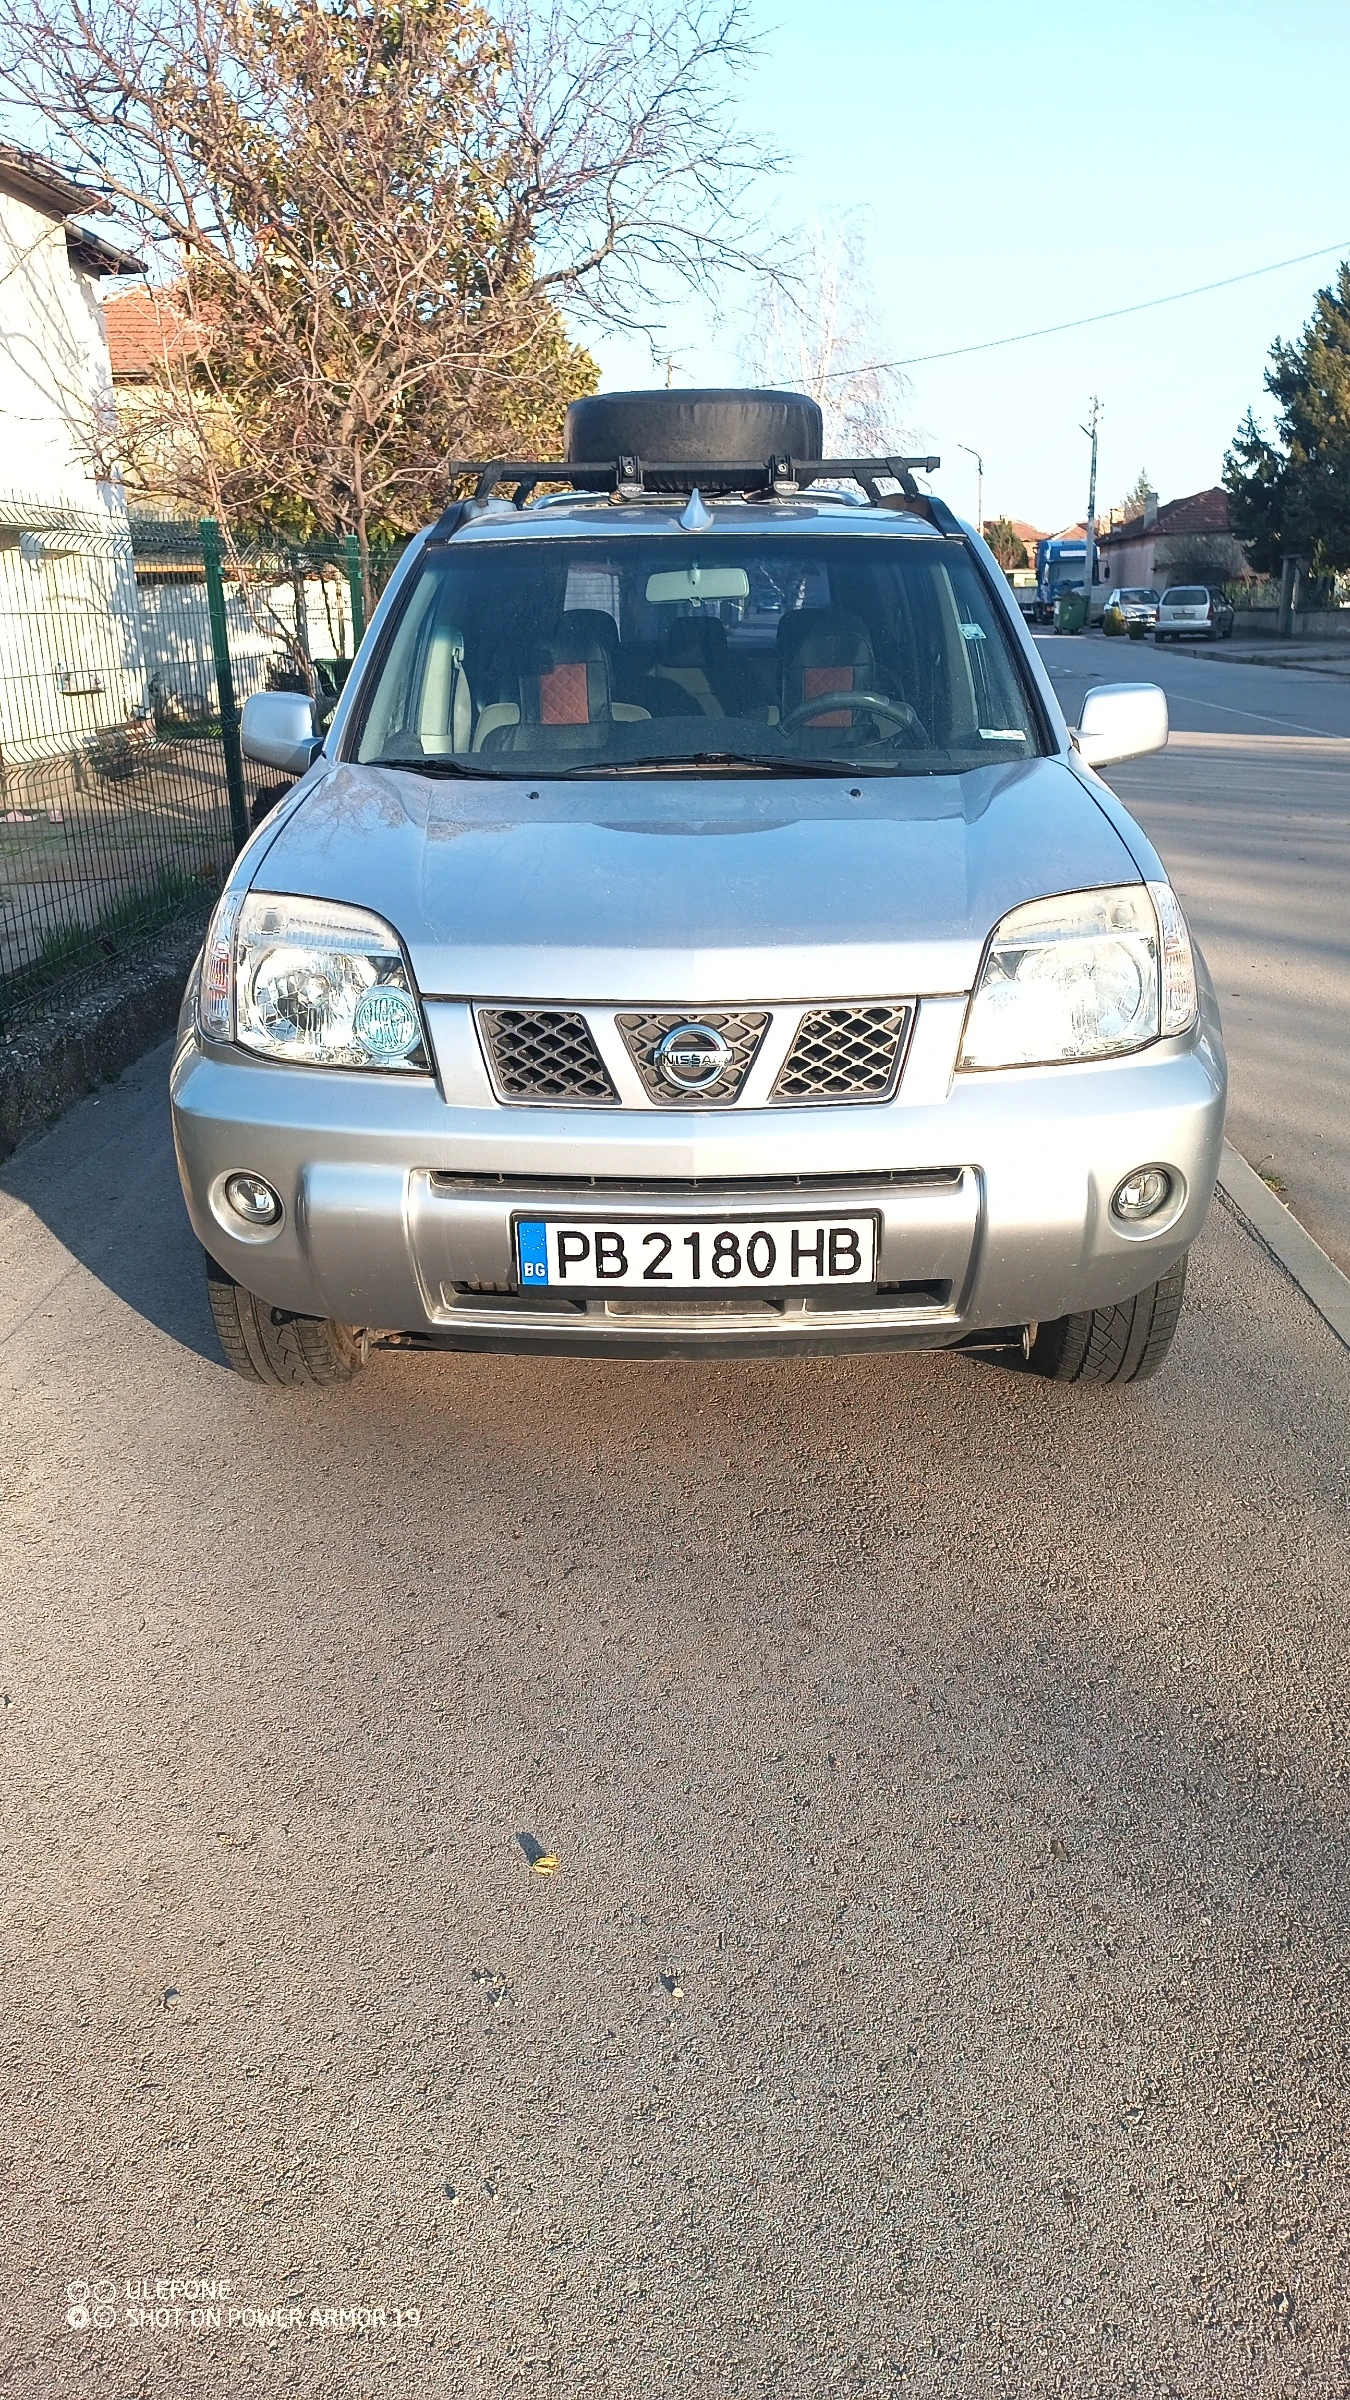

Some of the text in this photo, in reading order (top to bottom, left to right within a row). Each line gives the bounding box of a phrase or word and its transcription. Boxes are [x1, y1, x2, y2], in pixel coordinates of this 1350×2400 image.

[524, 1262, 546, 1277] BG
[557, 1228, 861, 1279] PB 2180 HB
